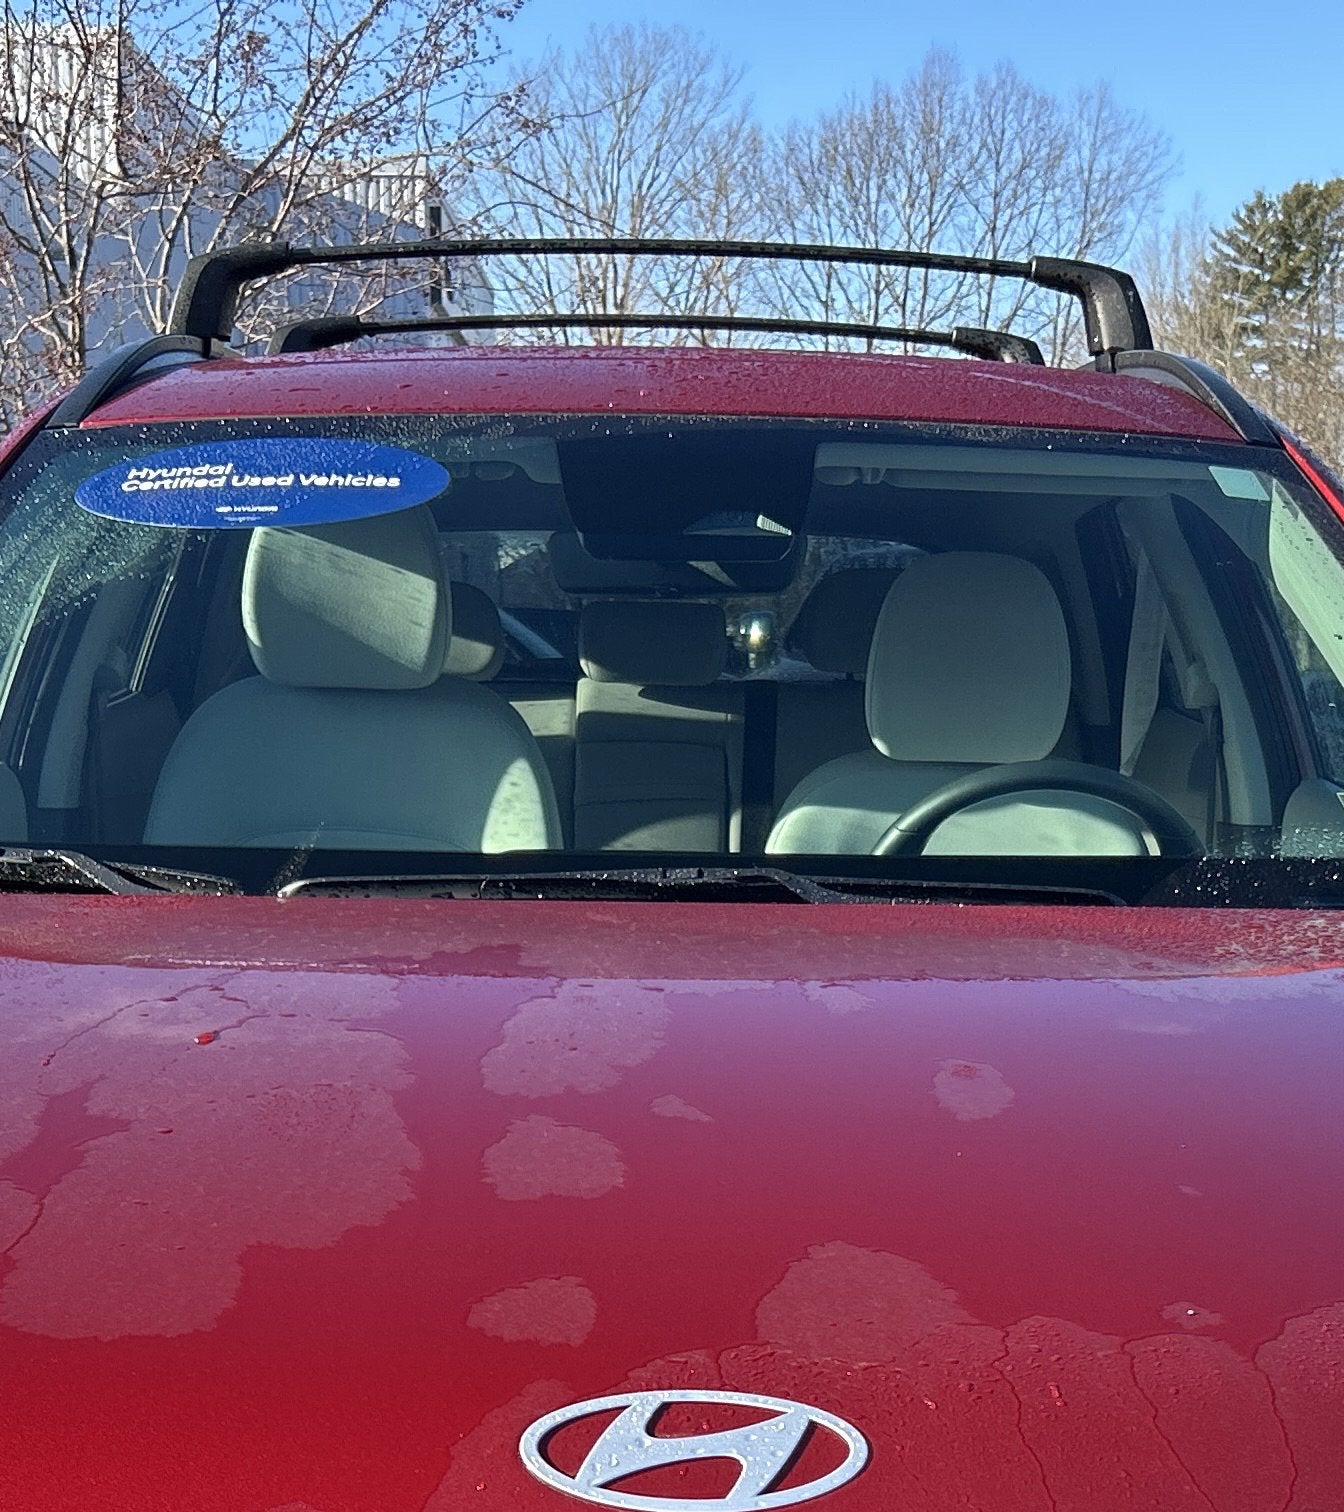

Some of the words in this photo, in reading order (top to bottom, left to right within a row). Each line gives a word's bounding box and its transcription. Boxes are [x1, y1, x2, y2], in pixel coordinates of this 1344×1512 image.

[127, 463, 233, 480] Hyundai
[121, 475, 225, 492] Certified
[231, 474, 294, 487] Used
[299, 473, 401, 487] Vehicles
